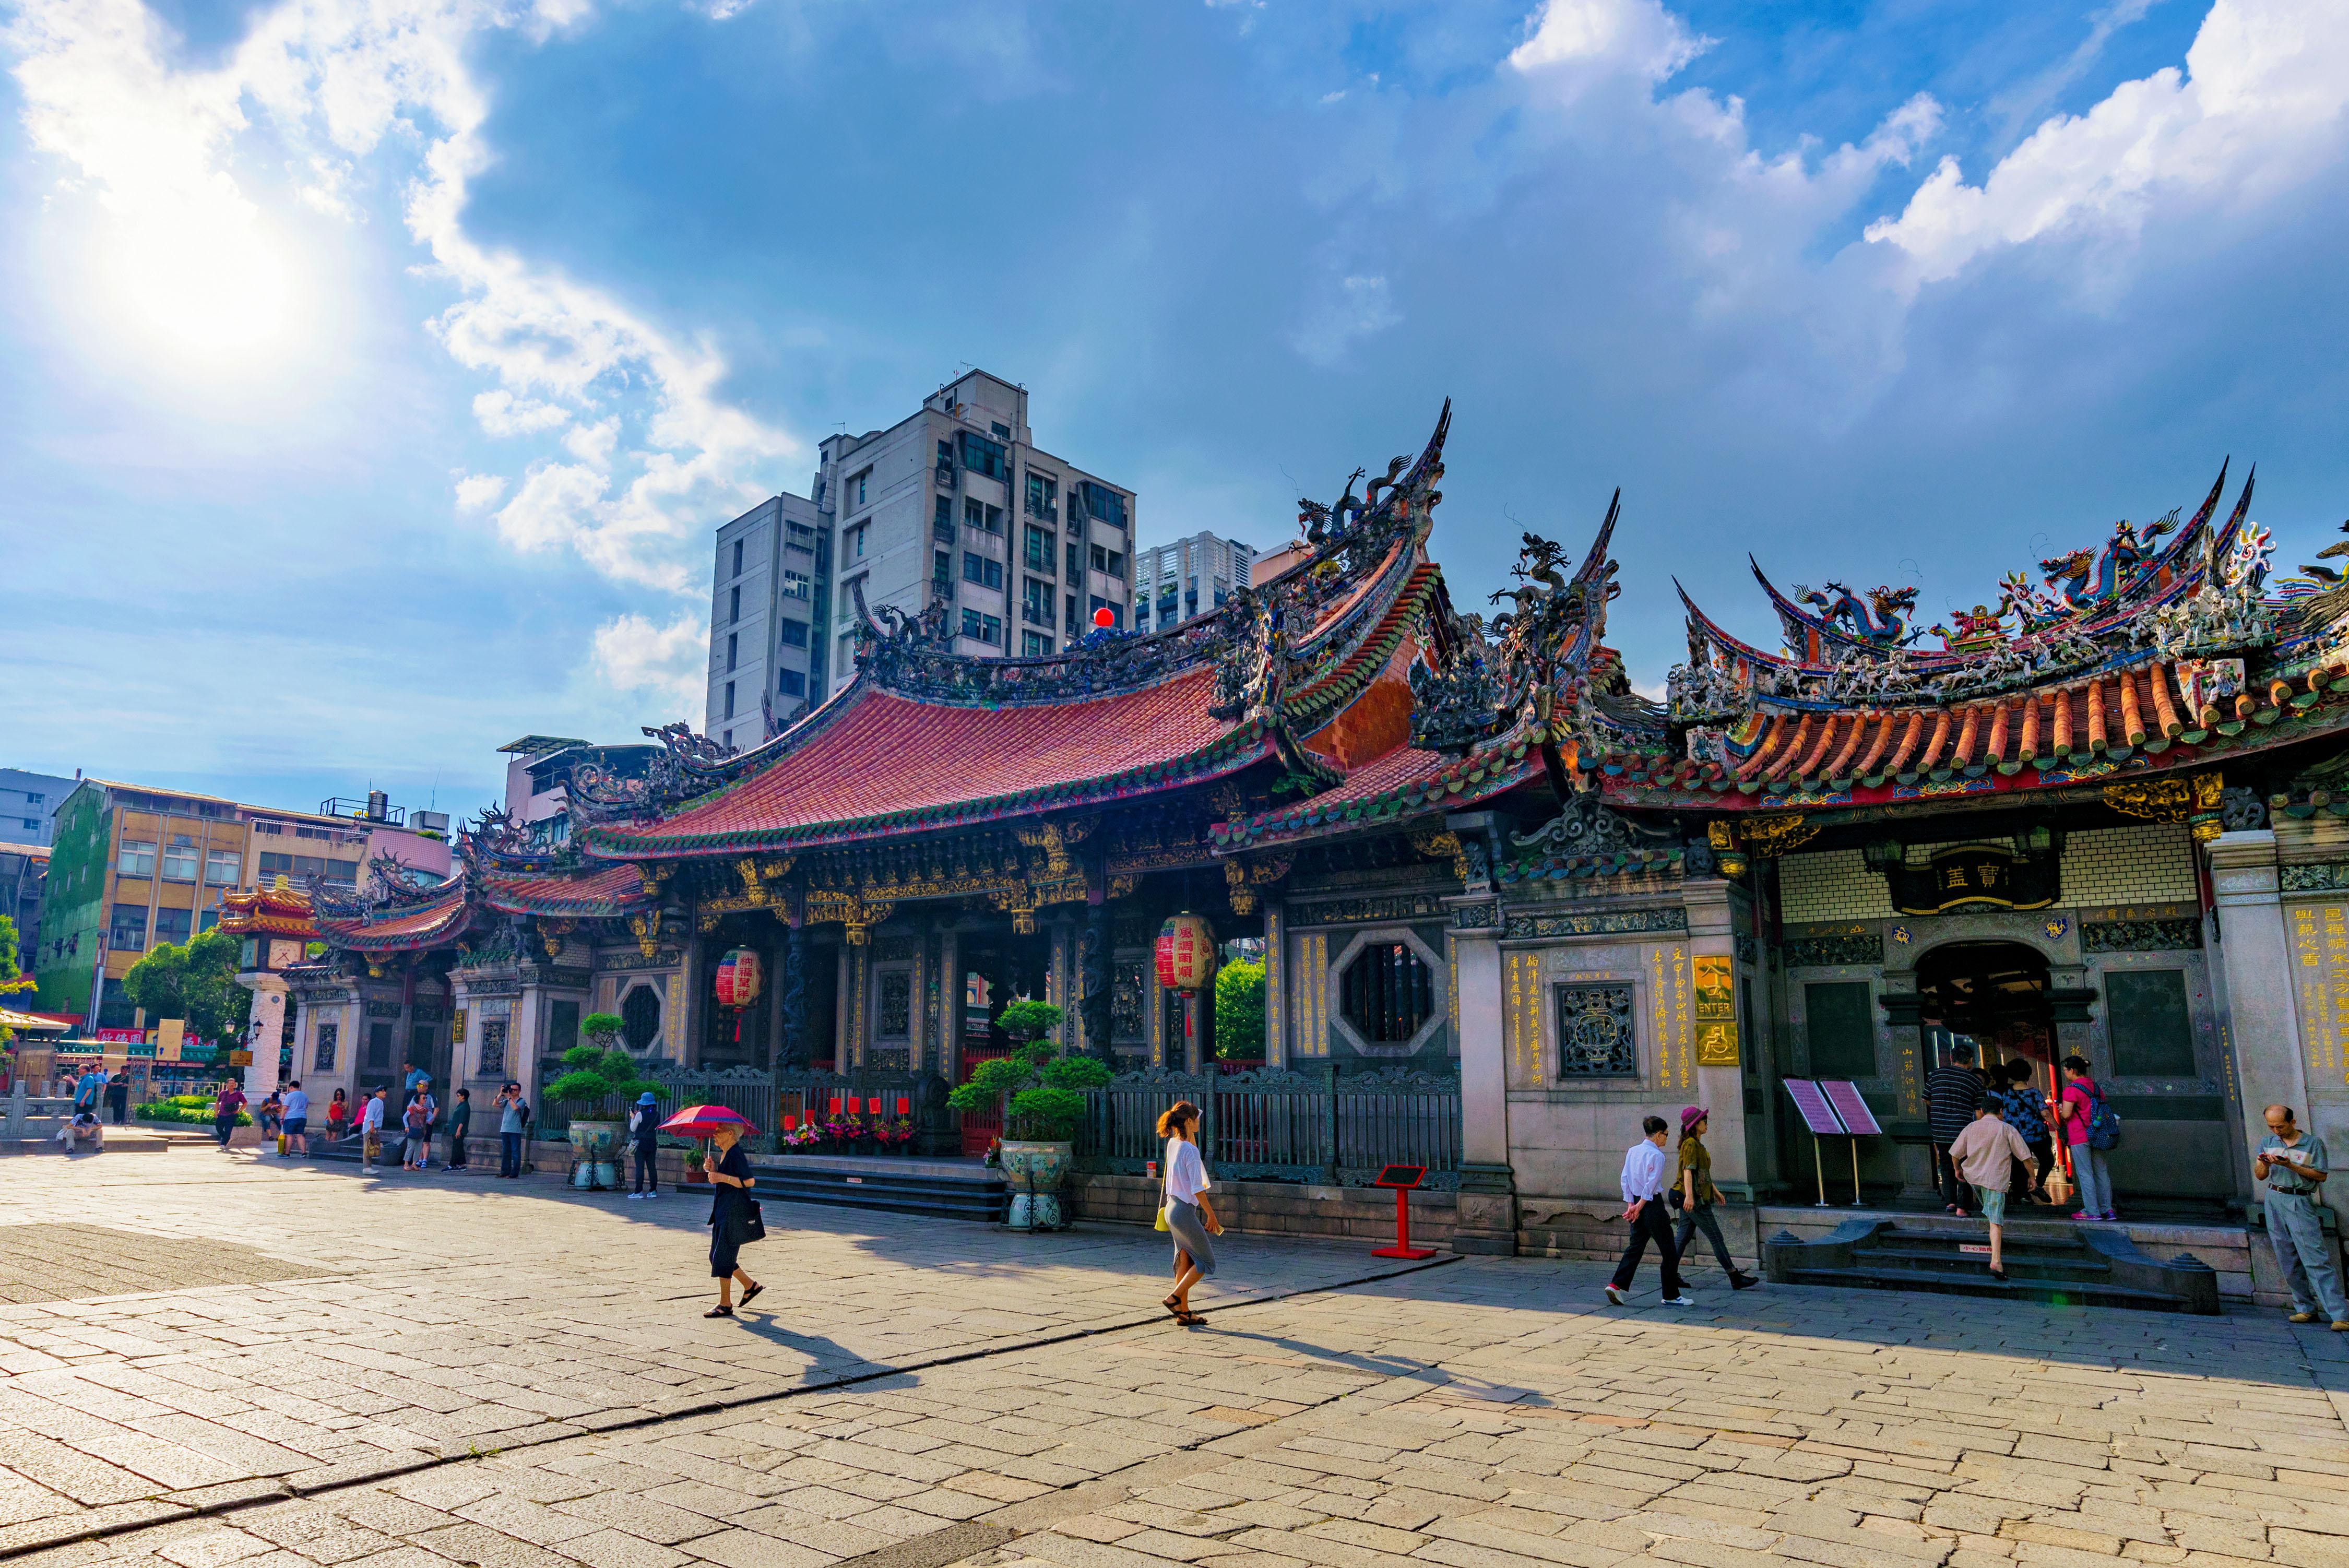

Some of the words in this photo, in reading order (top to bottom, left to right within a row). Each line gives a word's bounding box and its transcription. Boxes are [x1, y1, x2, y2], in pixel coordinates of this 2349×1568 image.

[1177, 927, 1193, 978] 風調雨順
[736, 957, 753, 999] 納福呈祥
[1701, 964, 1728, 996] 入口
[1699, 1003, 1730, 1013] ENTER
